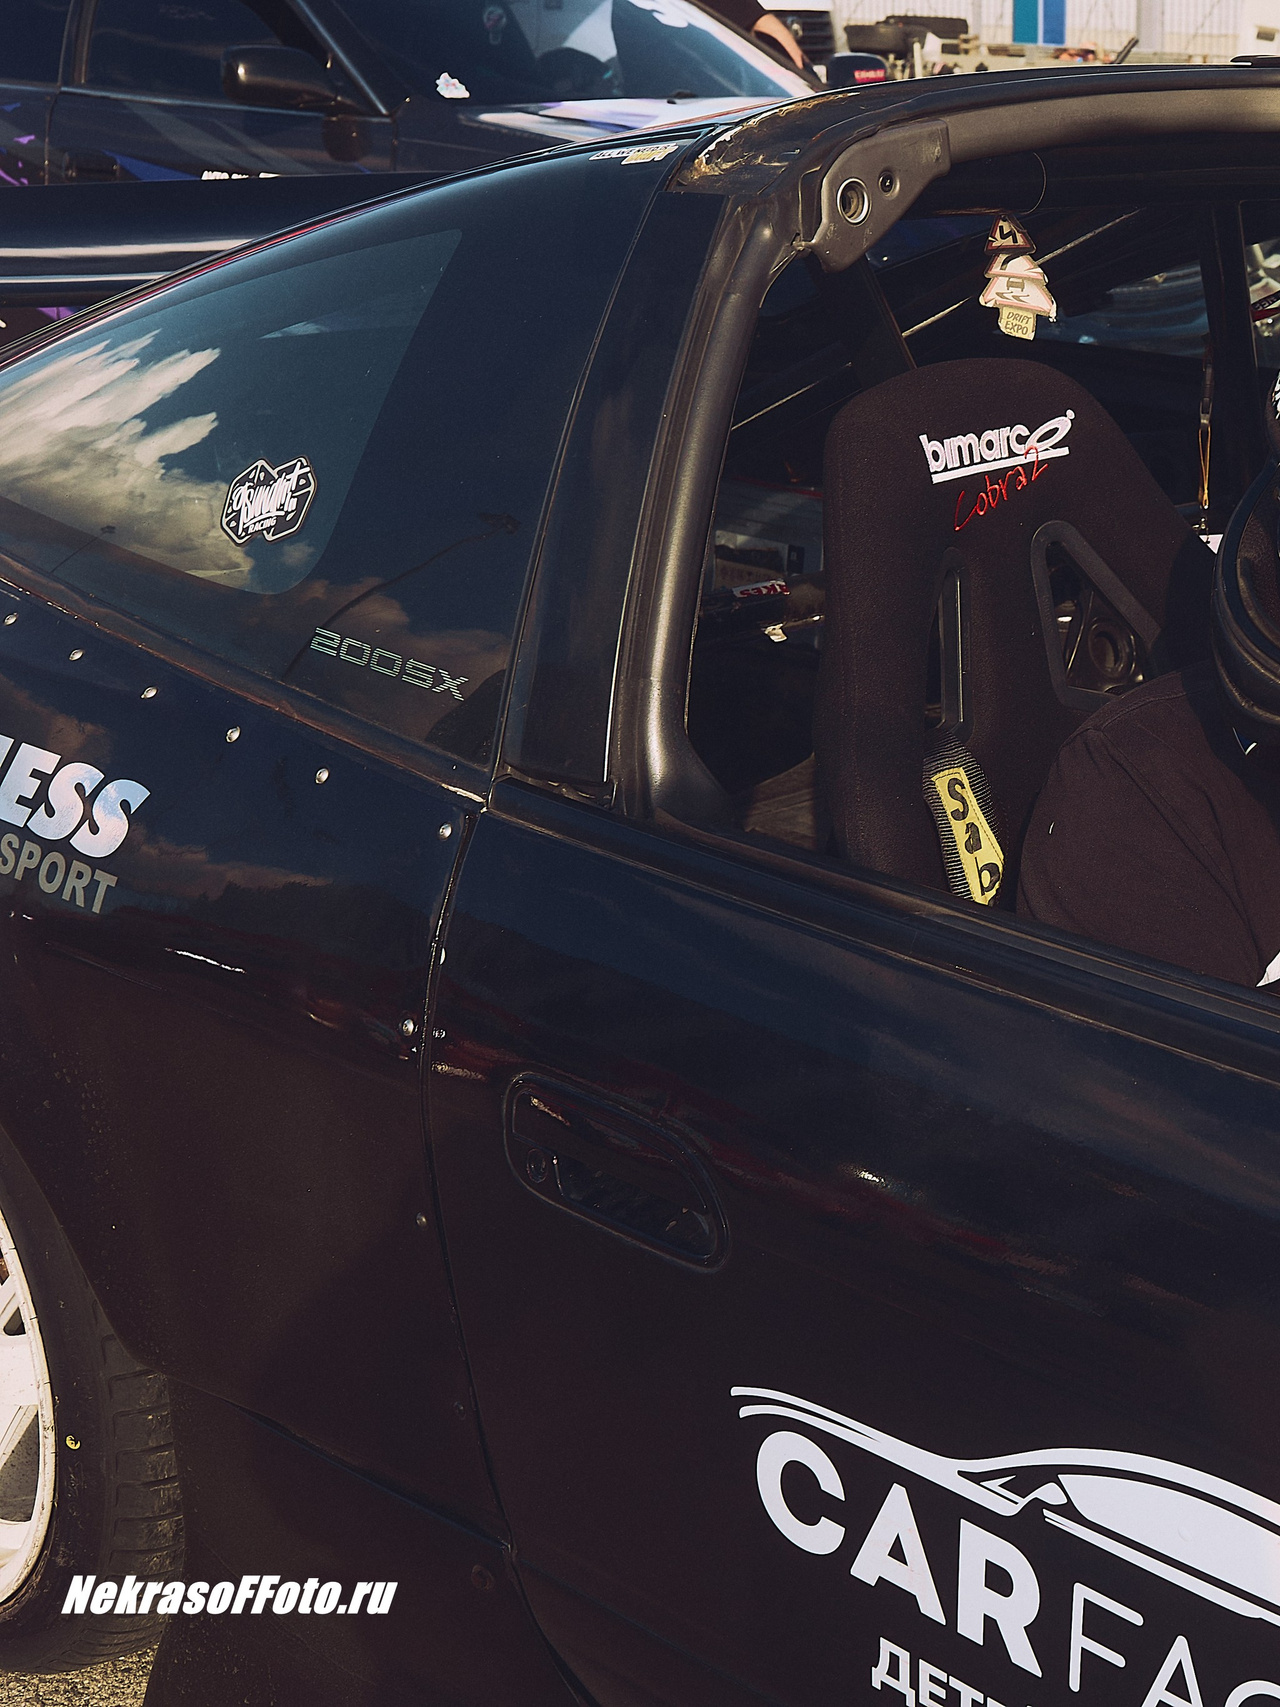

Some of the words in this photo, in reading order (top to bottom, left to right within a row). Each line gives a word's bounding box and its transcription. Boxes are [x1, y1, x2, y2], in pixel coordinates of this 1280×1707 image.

[1006, 311, 1032, 325] DRIFT
[1004, 320, 1029, 335] EXPO
[247, 516, 277, 534] RACING
[310, 626, 470, 701] 200SX
